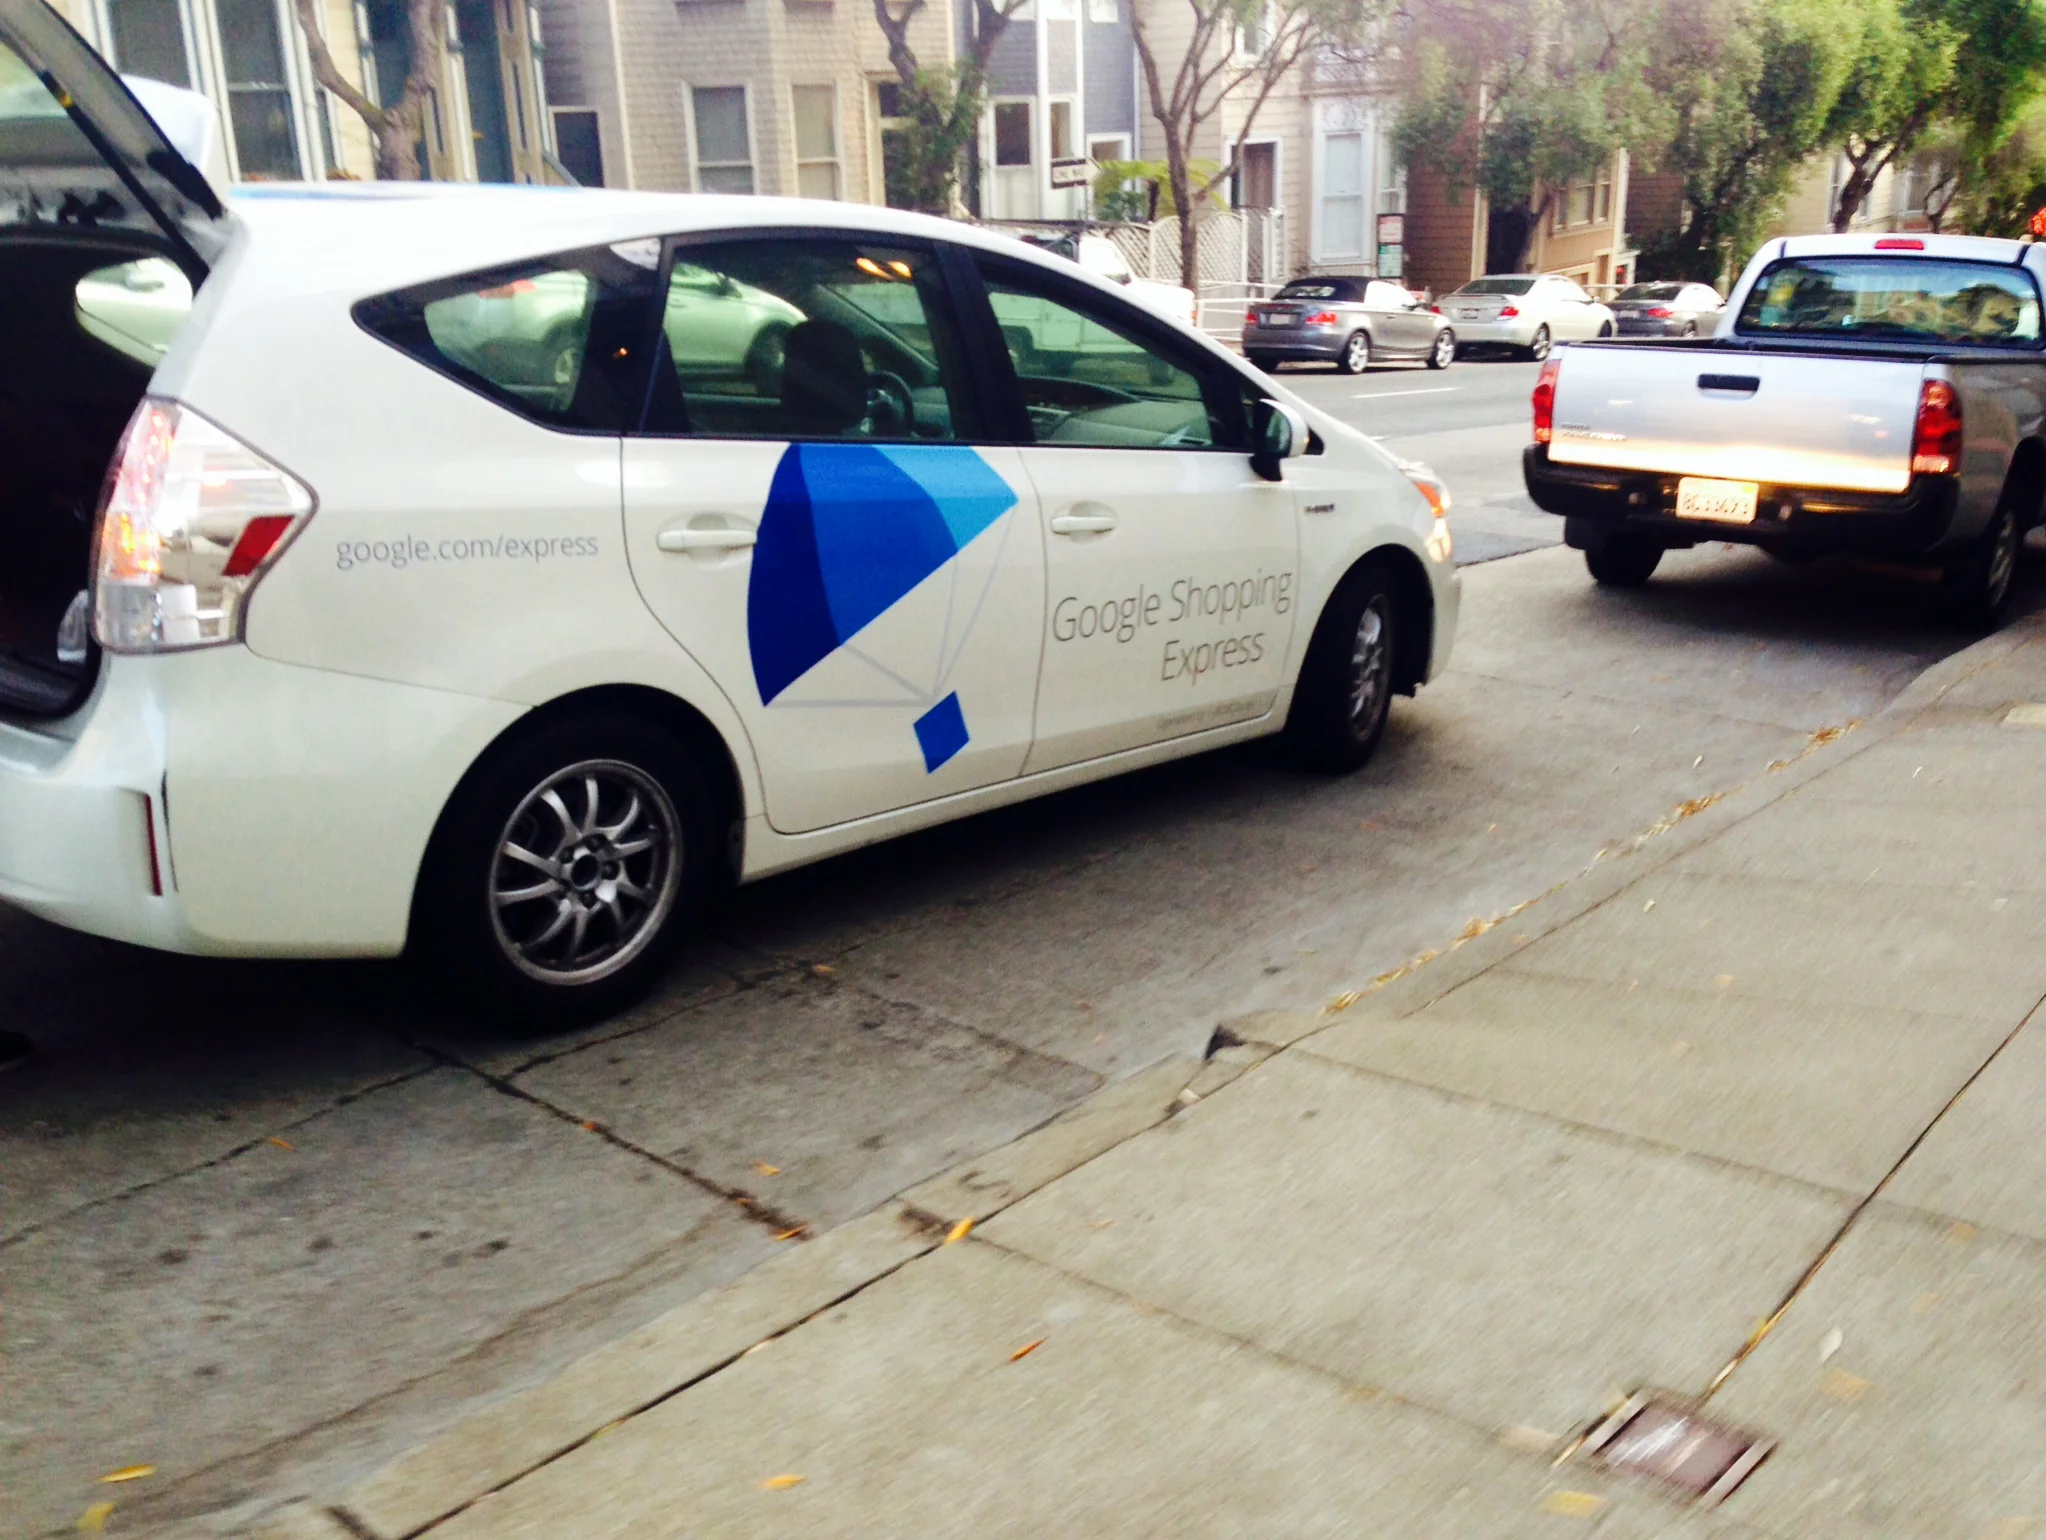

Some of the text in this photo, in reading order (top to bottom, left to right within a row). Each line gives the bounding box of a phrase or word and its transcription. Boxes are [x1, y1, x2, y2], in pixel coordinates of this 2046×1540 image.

[335, 532, 600, 571] google.com/express
[1052, 568, 1293, 643] Google Shopping
[1161, 632, 1265, 687] Express
